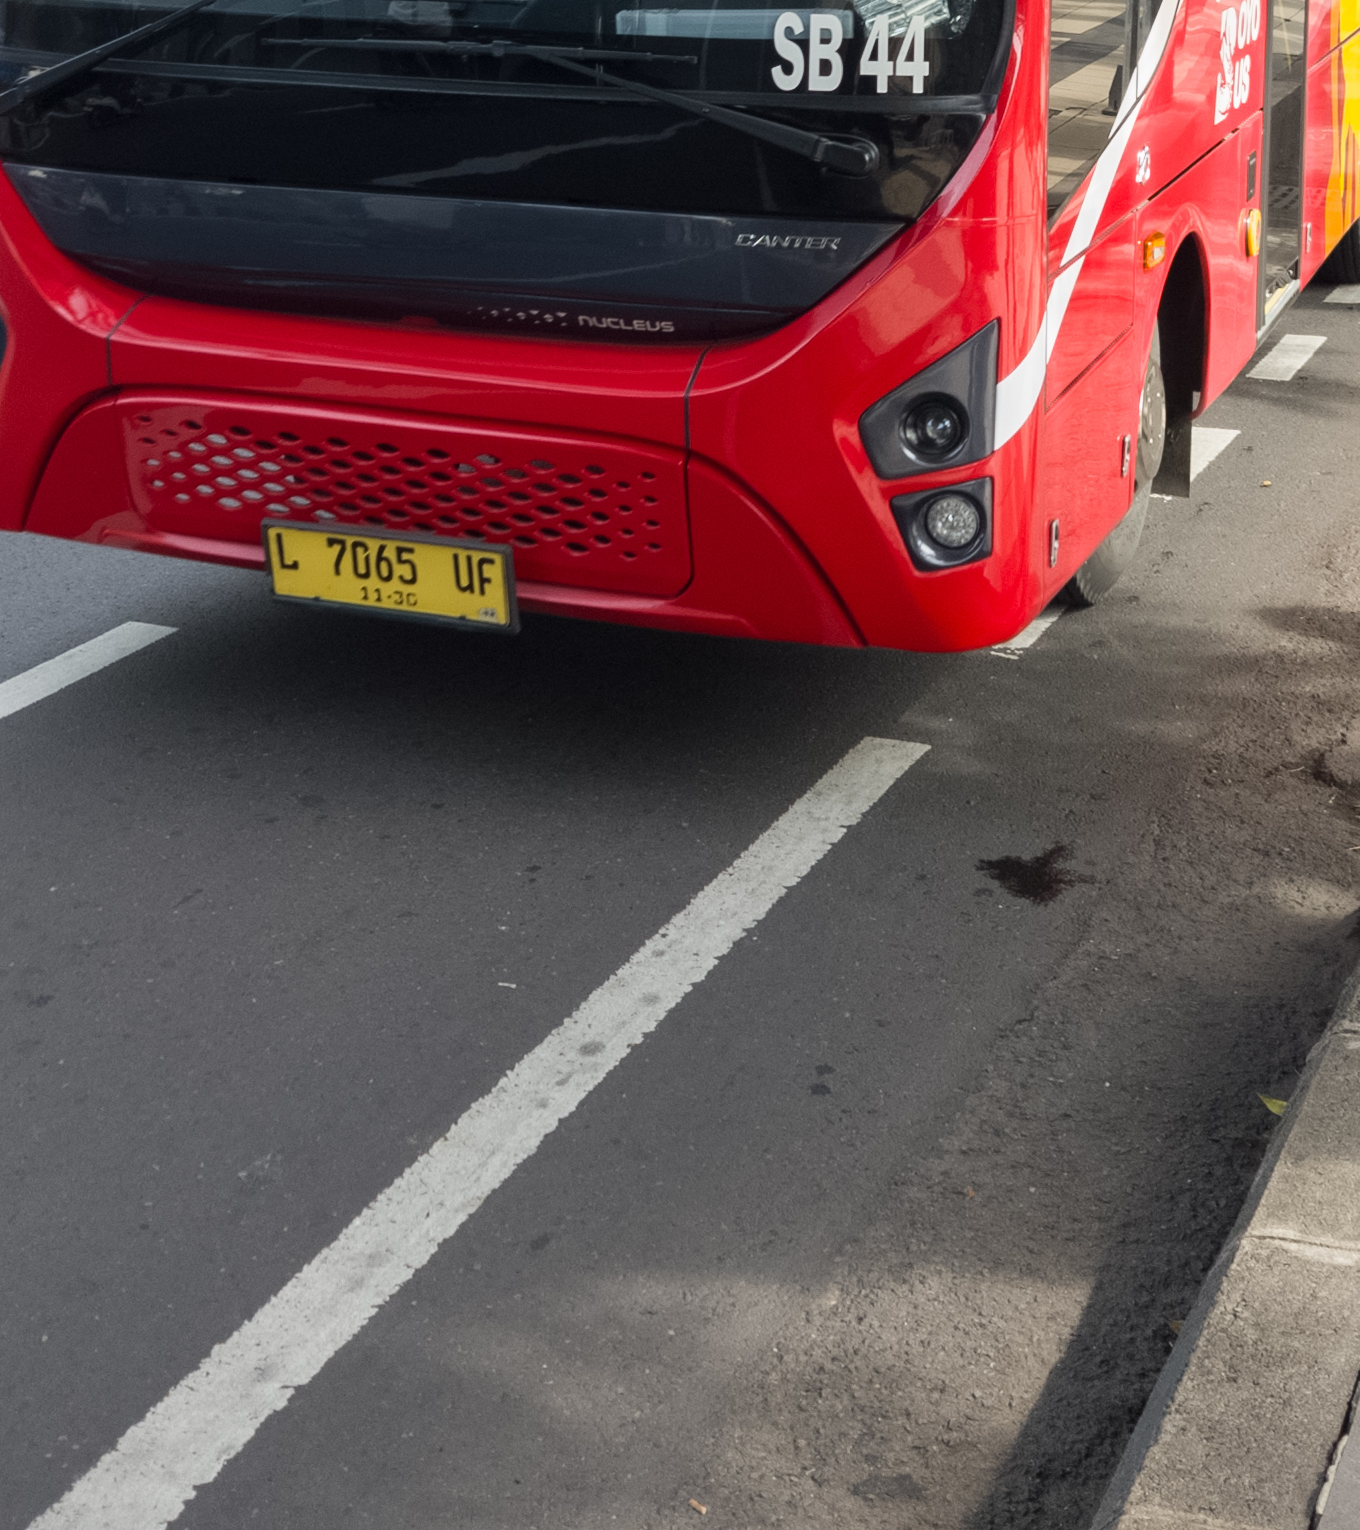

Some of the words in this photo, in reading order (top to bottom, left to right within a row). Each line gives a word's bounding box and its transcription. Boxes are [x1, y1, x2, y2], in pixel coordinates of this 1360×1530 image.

[771, 11, 844, 93] SB
[859, 14, 930, 94] 44
[735, 234, 842, 250] CANTER
[578, 315, 675, 332] NUCLEUS
[275, 532, 300, 571] L
[326, 536, 418, 585] 7065
[452, 552, 496, 596] UF
